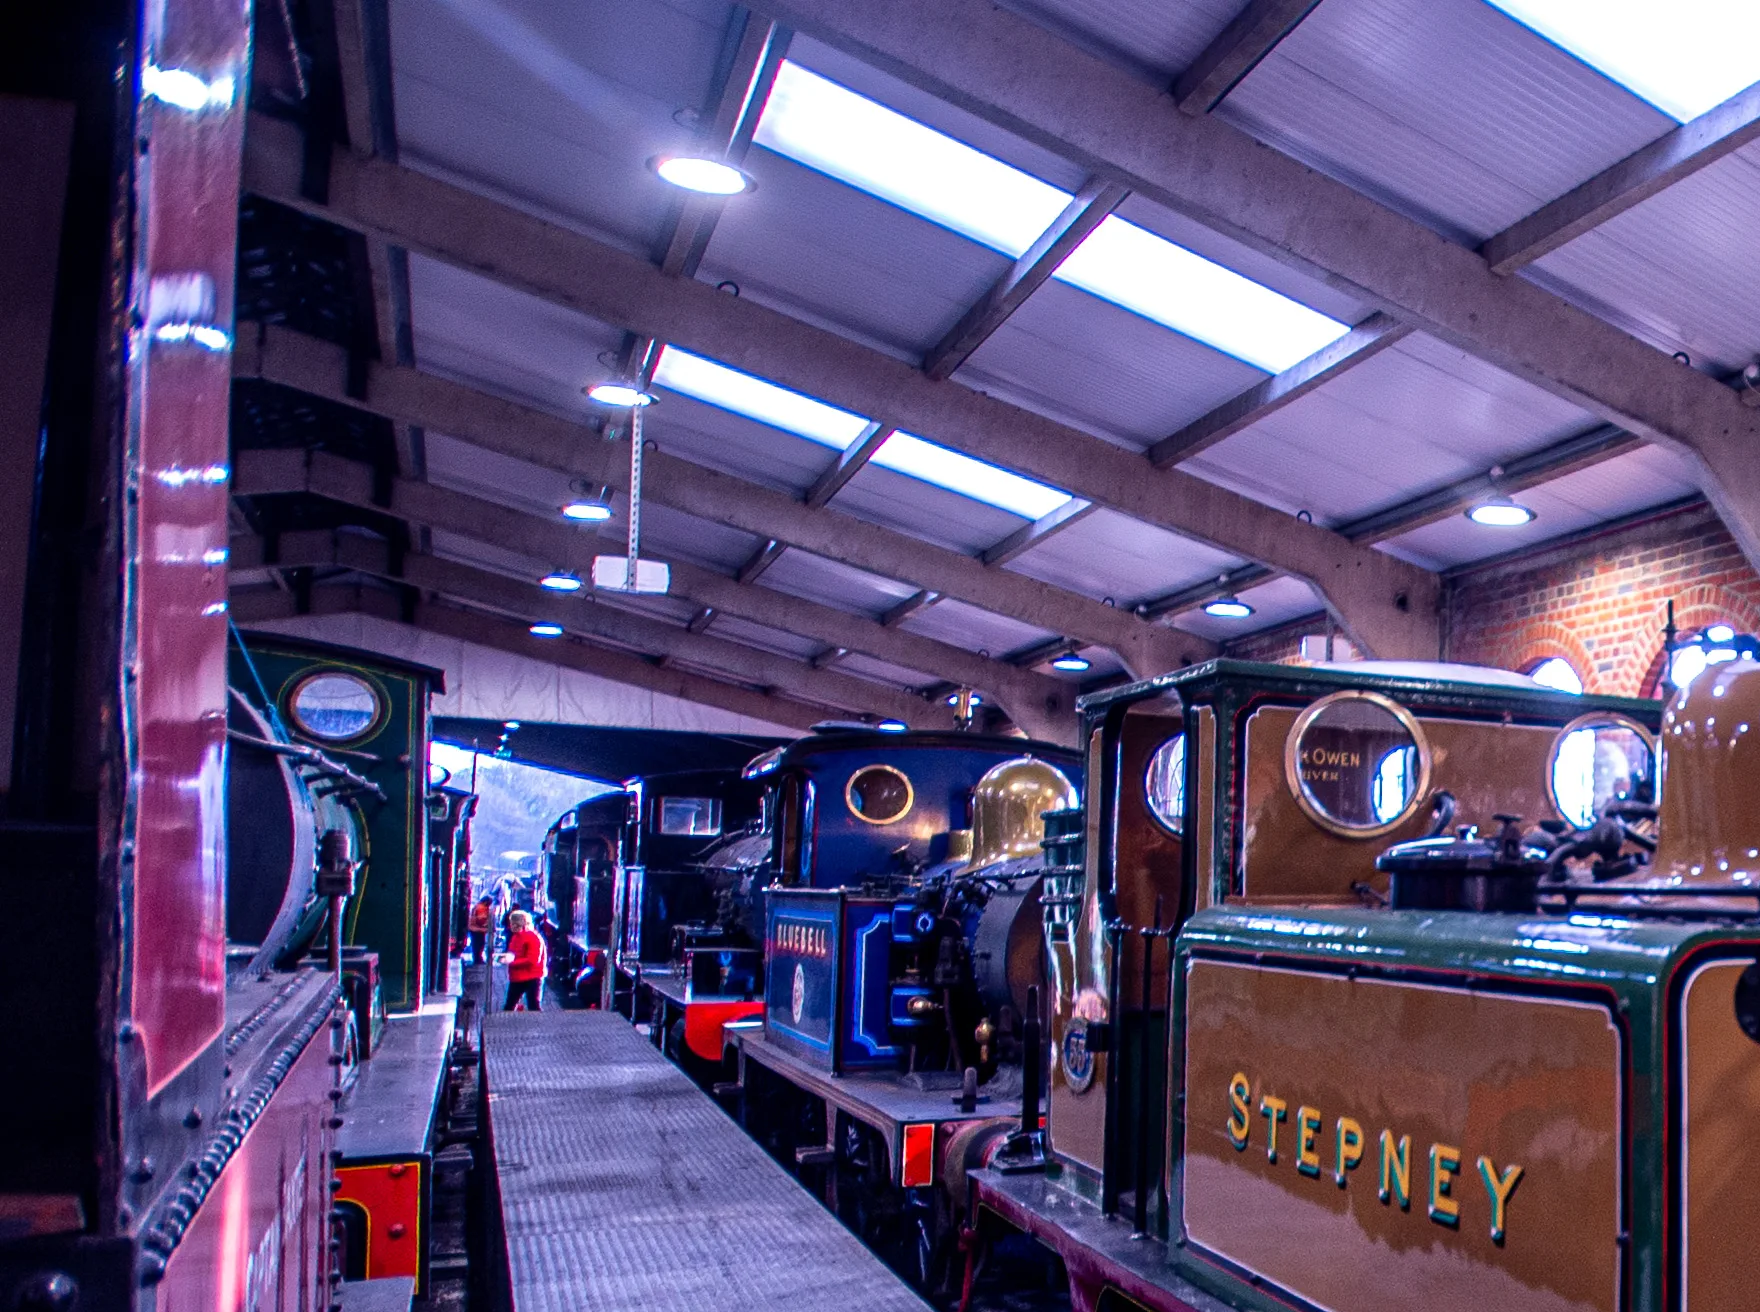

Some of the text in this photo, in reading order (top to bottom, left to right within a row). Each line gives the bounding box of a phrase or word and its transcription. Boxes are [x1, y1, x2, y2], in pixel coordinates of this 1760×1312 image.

[1313, 748, 1361, 768] OWEN
[776, 923, 827, 958] BLUEBELL
[1225, 1071, 1525, 1247] STEPNEY
